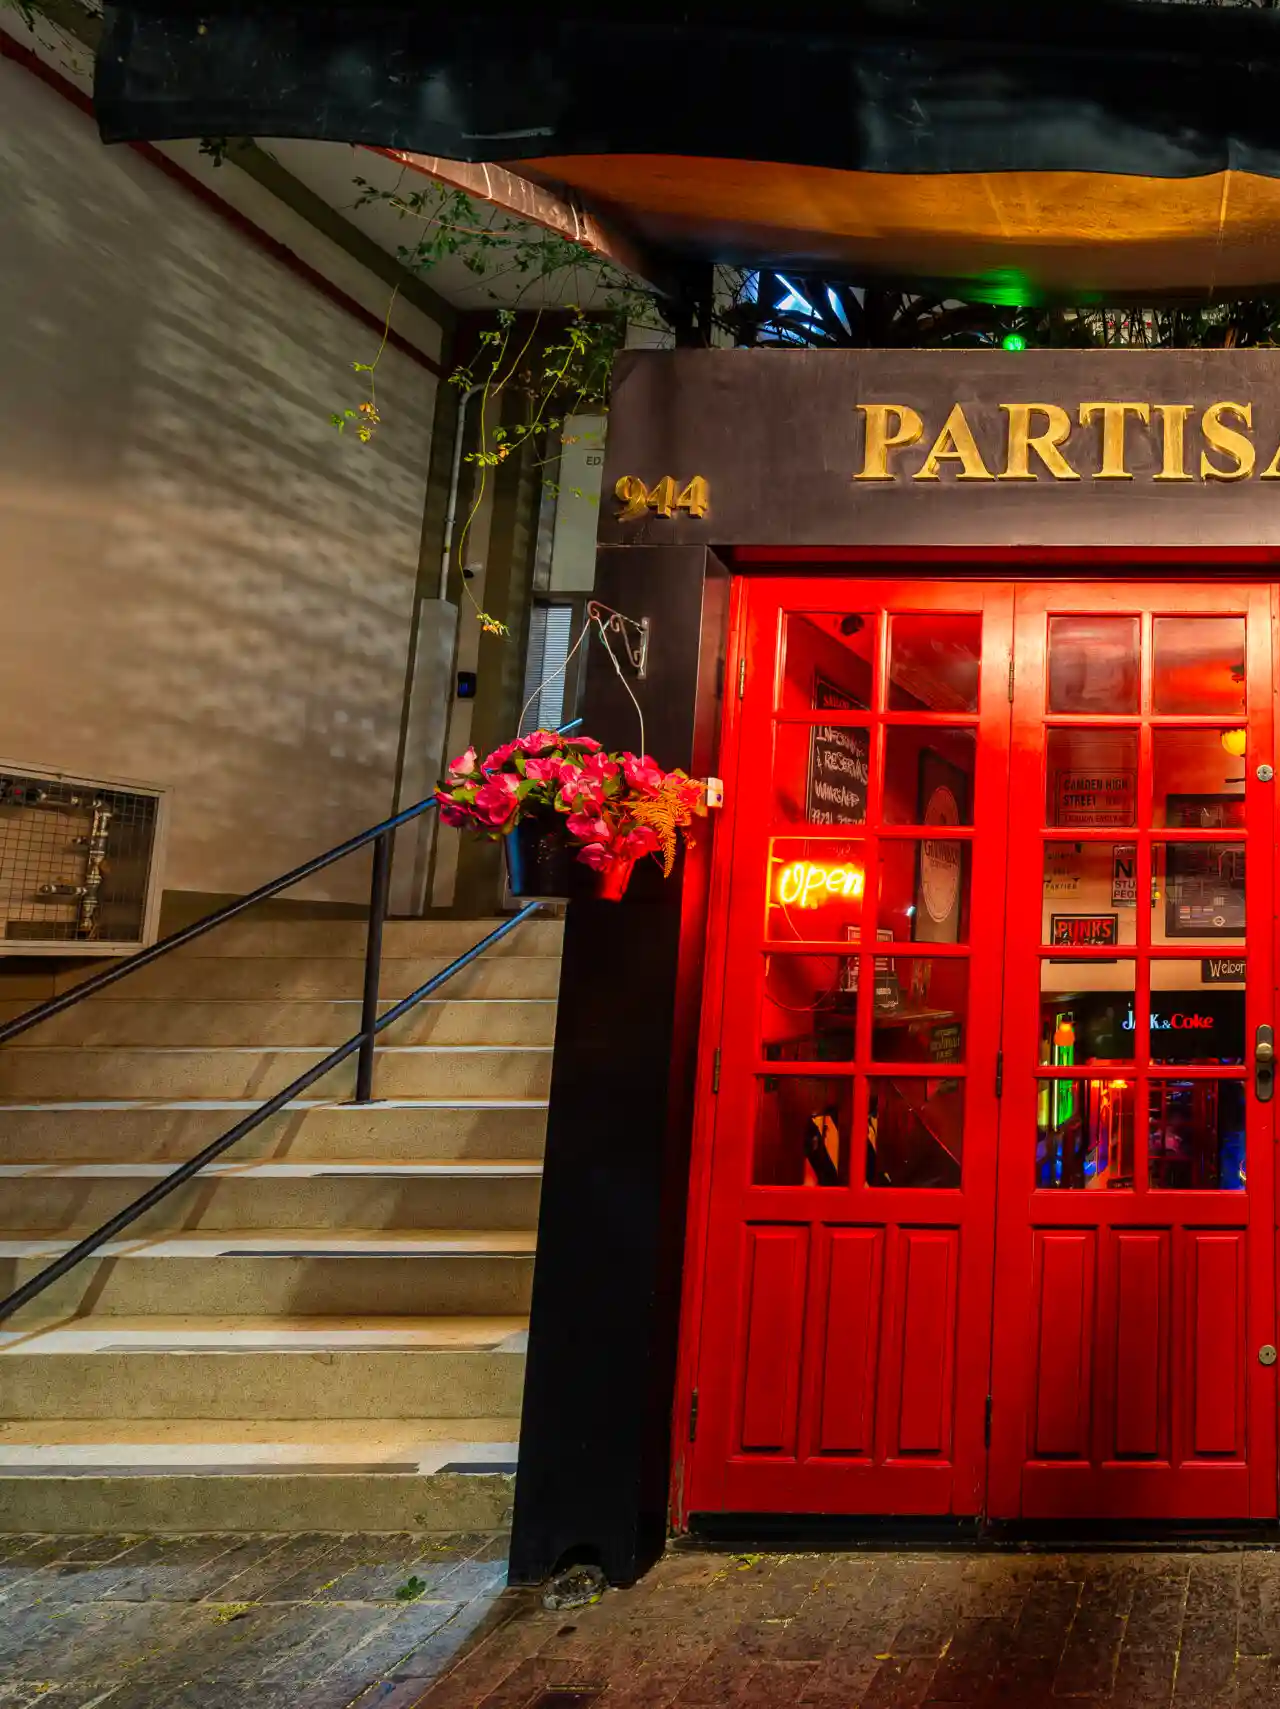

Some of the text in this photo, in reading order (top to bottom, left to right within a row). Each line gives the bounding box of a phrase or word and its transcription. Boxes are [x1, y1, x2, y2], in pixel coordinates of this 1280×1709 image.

[614, 475, 708, 522] 944
[1063, 779, 1103, 791] CAMDEN
[1063, 794, 1097, 807] STREET
[778, 862, 863, 908] Open
[1209, 959, 1246, 977] Welco
